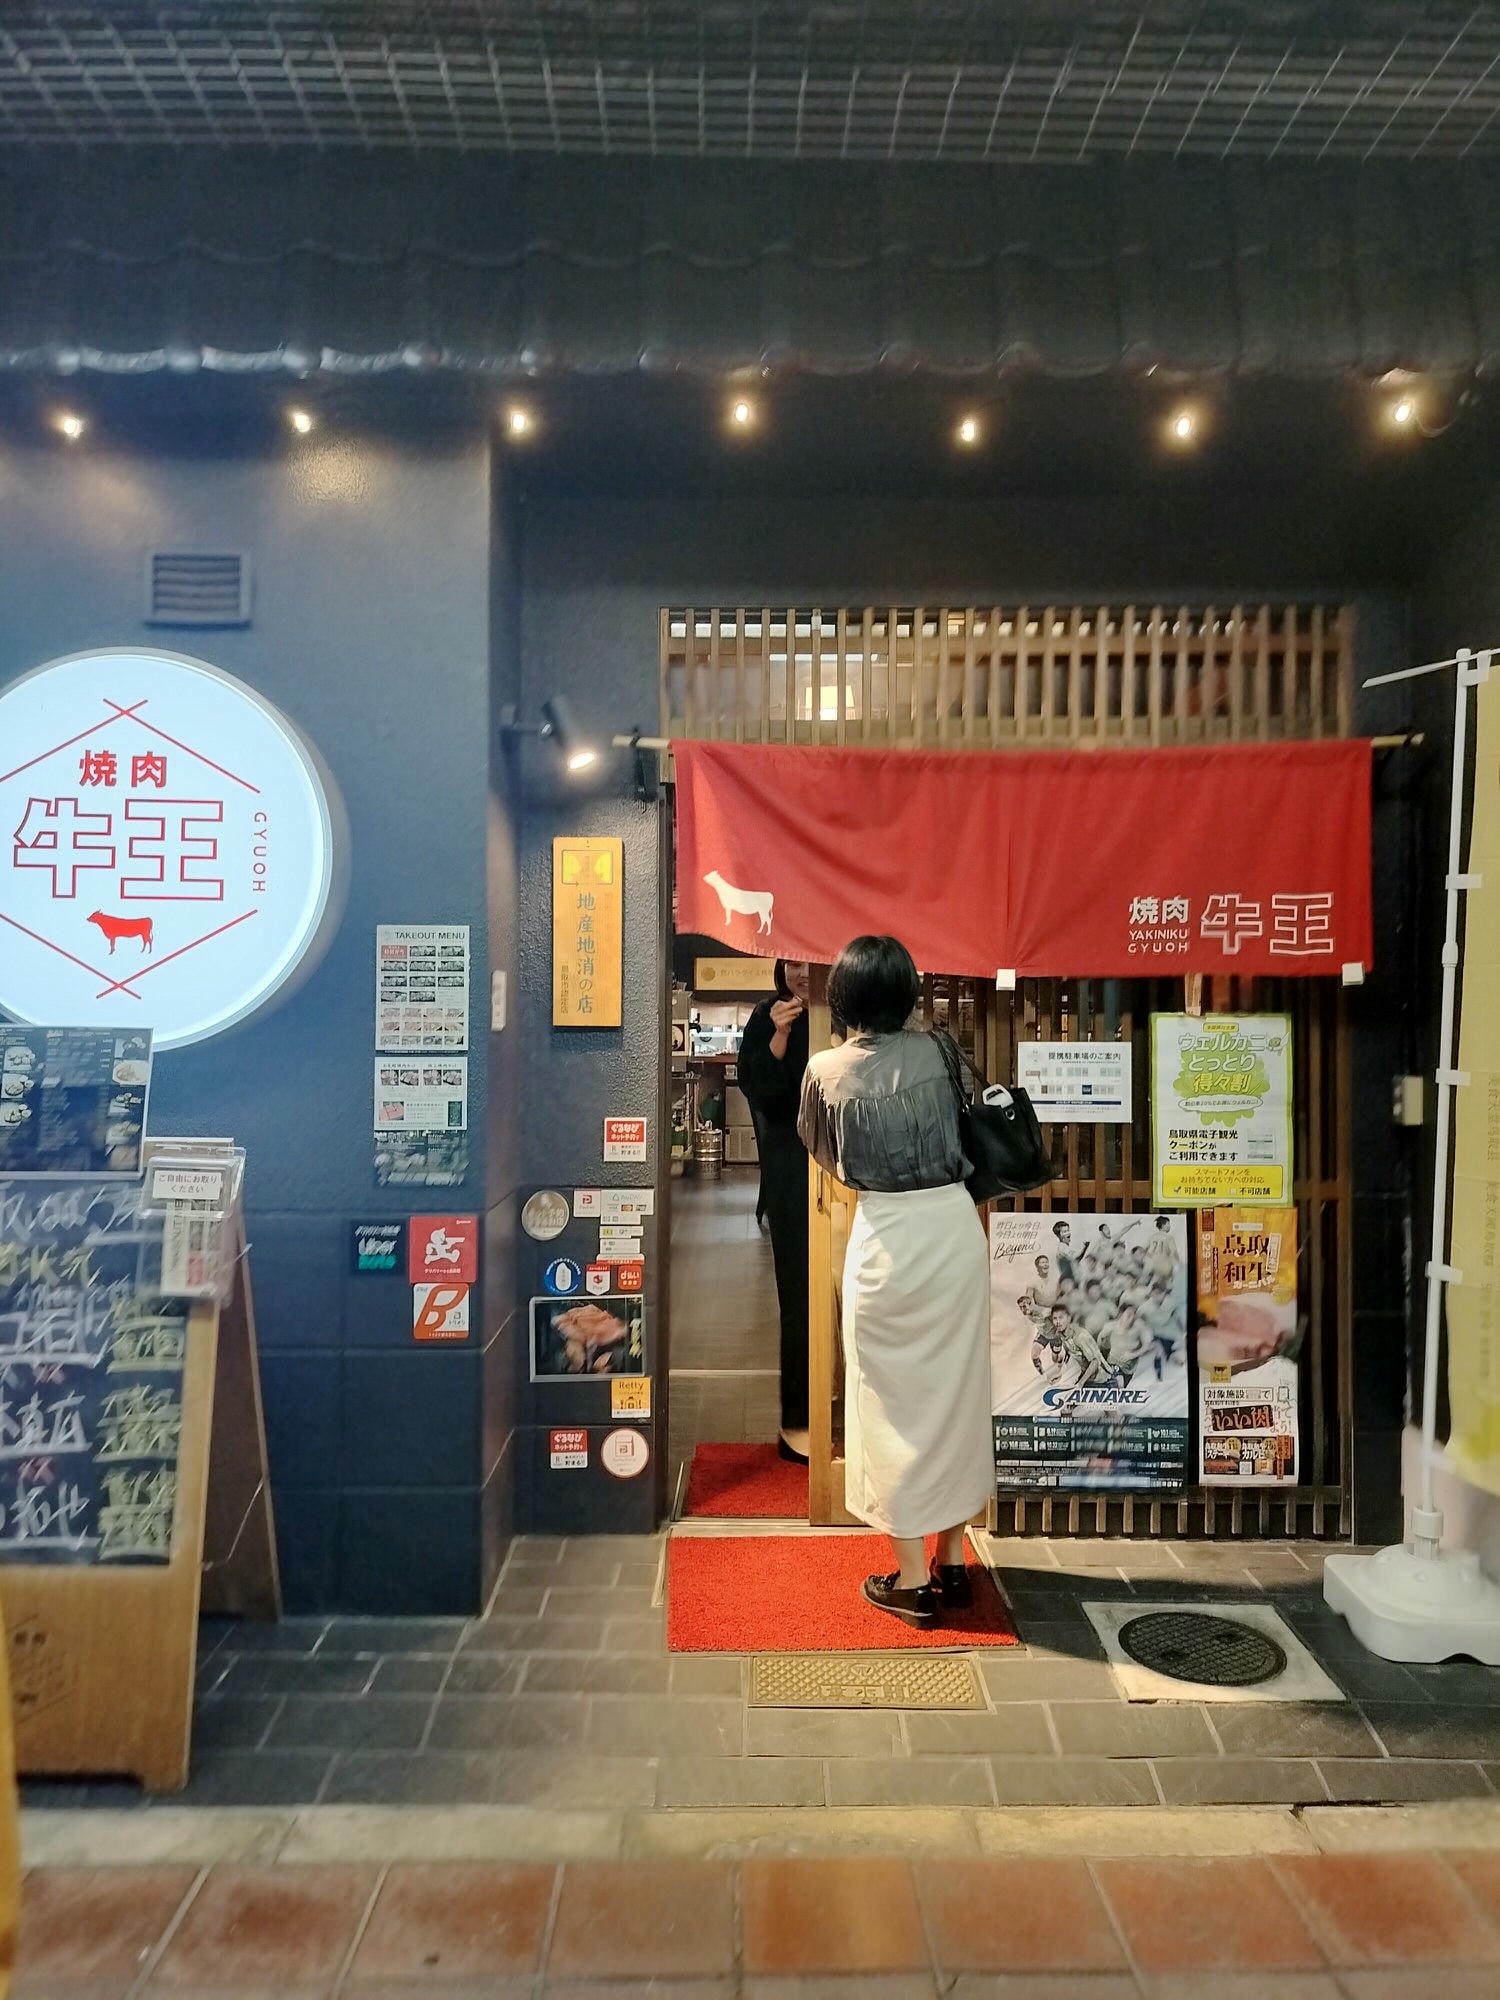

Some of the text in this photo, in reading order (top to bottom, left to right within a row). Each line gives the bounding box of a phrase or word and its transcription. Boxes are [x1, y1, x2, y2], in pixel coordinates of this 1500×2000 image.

[79, 750, 168, 788] 焼肉
[13, 797, 224, 901] 牛王
[252, 811, 268, 893] GYUOH
[1129, 896, 1189, 925] 焼肉
[1200, 893, 1335, 955] 牛王
[395, 932, 465, 940] TAKEOUT MENU
[1129, 928, 1189, 941] YAKINIKU
[576, 892, 596, 1015] 地産地消の店
[1128, 942, 1189, 954] GYUOH
[1048, 1052, 1121, 1060] 提携駐車場のご案内
[1188, 1053, 1256, 1072] とっとり
[1193, 1073, 1252, 1093] 得々割
[610, 1123, 641, 1134] ぐるなび
[1169, 1129, 1239, 1140] 鳥取県電子観光
[1169, 1140, 1217, 1150] クーポンが
[1169, 1151, 1239, 1161] ご利用できます
[158, 1174, 217, 1184] ご自由にお取り
[993, 1241, 1040, 1263] Beyond
[619, 1381, 644, 1390] Retty
[1042, 1387, 1150, 1412] GAINARE
[553, 1433, 583, 1443] ぐるなび
